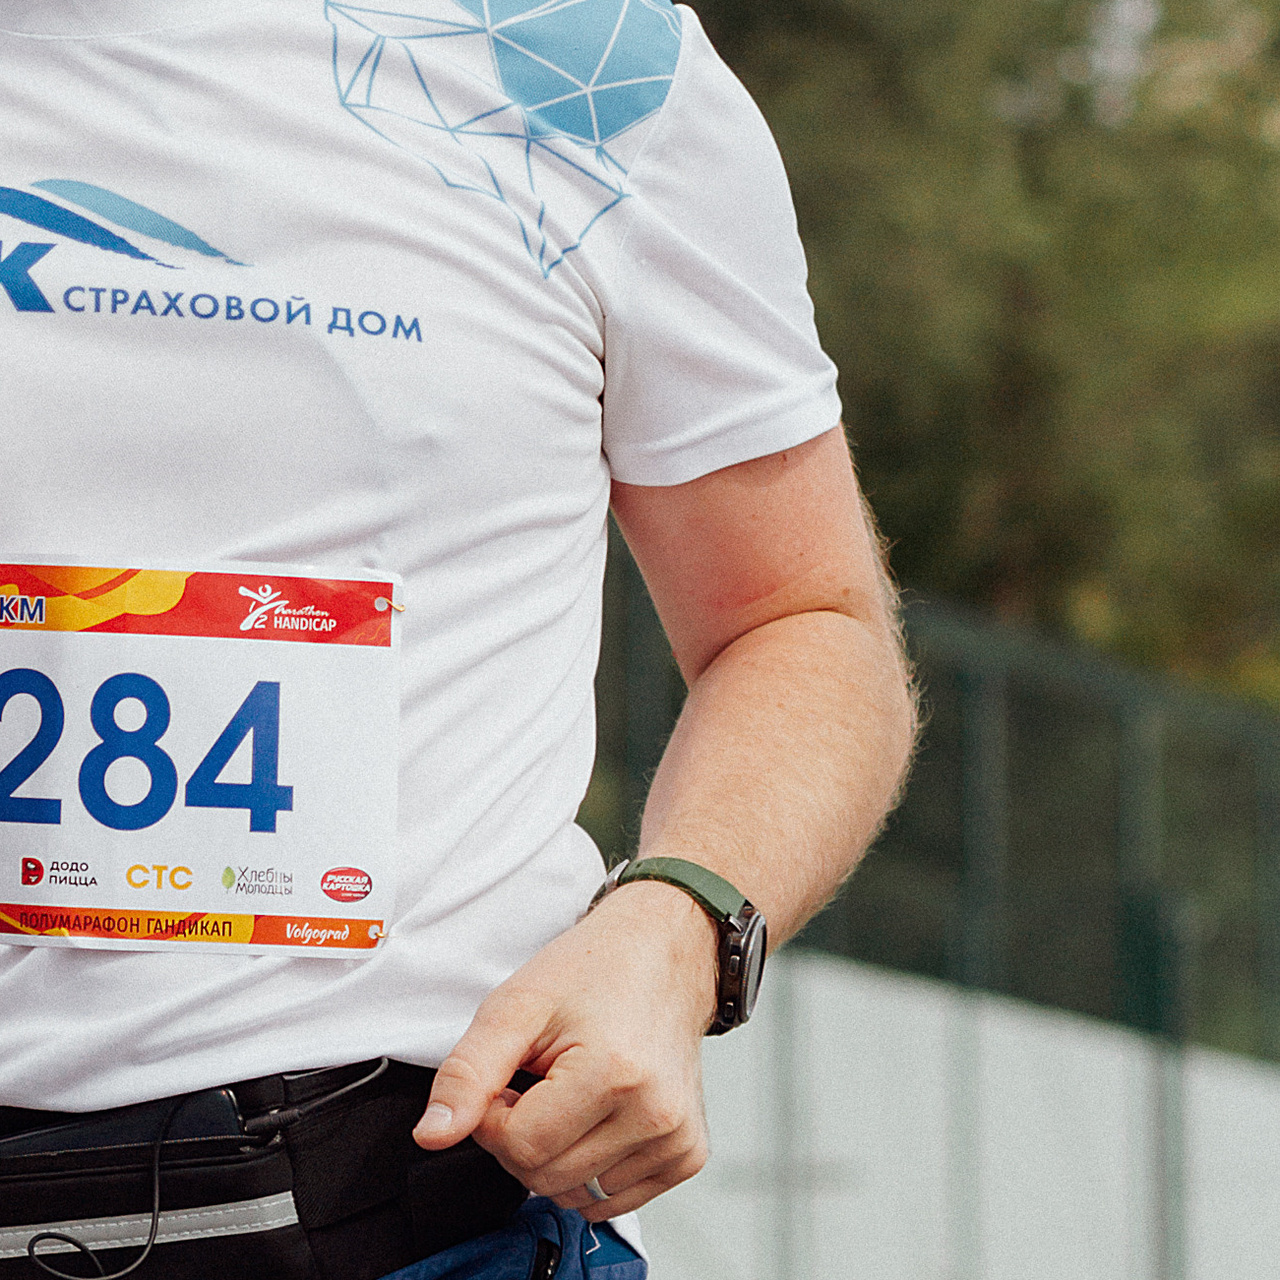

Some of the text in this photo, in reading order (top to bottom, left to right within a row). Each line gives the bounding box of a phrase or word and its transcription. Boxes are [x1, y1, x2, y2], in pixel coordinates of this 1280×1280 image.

[62, 286, 312, 327] СТРАХОВОЙ
[327, 307, 424, 343] ДОМ
[273, 616, 337, 632] HANDICAP
[49, 861, 89, 873] ДОДО
[125, 864, 193, 890] СТС
[48, 875, 98, 887] ПИЦЦА
[19, 912, 233, 938] ПОЛУМАРАФОН ГАНДИКАП
[285, 922, 350, 945] Volgograd
